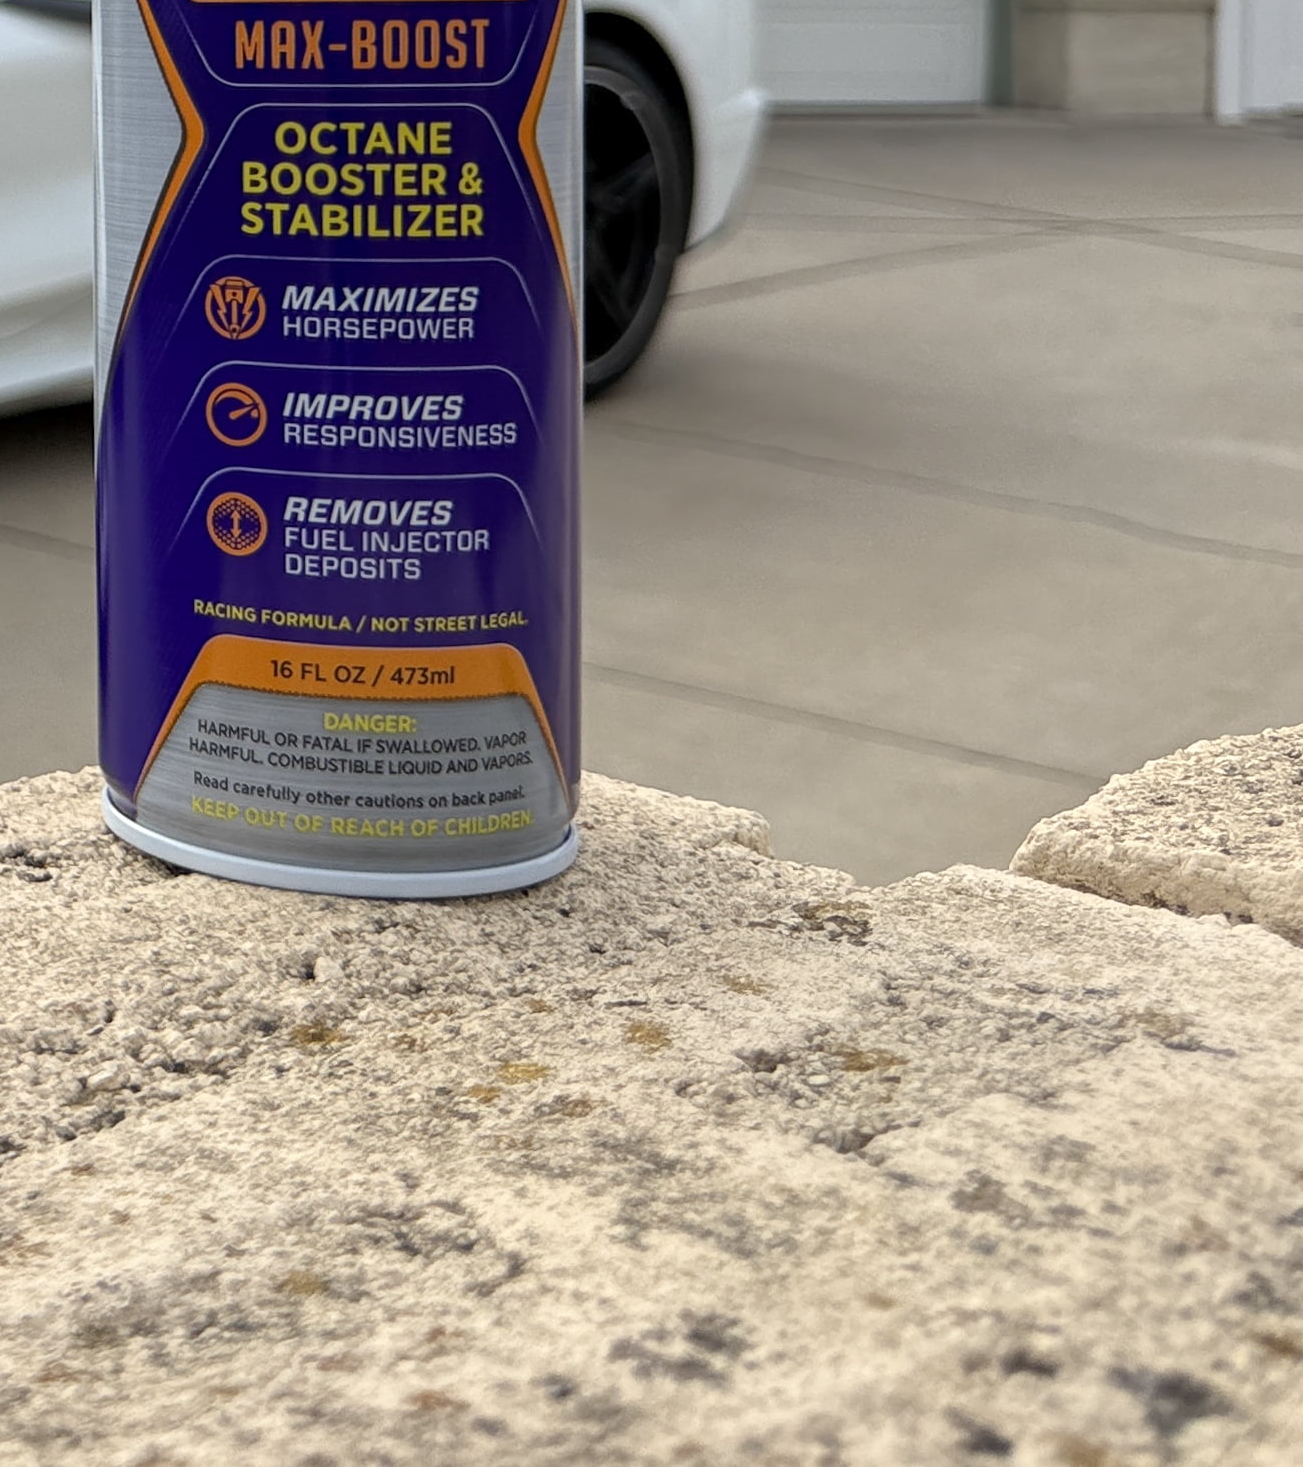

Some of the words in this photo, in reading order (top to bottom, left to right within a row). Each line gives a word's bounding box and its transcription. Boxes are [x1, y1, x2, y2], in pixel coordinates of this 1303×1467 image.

[235, 19, 490, 69] MAX-BOOST
[275, 121, 453, 155] OCTANE
[242, 162, 448, 196] BOOSTER
[458, 163, 484, 195] &
[241, 203, 485, 237] STABILIZER
[282, 285, 480, 313] MAXIMIZES
[283, 316, 474, 340] HORSEPOWER
[283, 392, 465, 421] IMPROVES
[283, 422, 518, 448] RESPONSIVENESS
[283, 496, 453, 526] REMOVES
[284, 527, 354, 552] FUEL
[362, 529, 490, 554] INJECTOR
[285, 553, 421, 580] DEPOSITS
[193, 598, 257, 623] RACING
[261, 608, 352, 632] FORMULA
[356, 615, 367, 633] /
[371, 616, 410, 633] NOT
[414, 614, 478, 633] STREET
[270, 659, 293, 680] 16
[300, 662, 327, 683] FL
[334, 664, 366, 686] OZ
[371, 664, 386, 688] /
[390, 665, 455, 685] 473ml
[198, 718, 270, 746] HARMFUL
[274, 732, 298, 748] OR
[302, 734, 353, 753] FATAL
[357, 738, 374, 754] IF
[375, 737, 481, 755] SWALLOWED.
[483, 730, 527, 750] VAPOR
[324, 711, 417, 733] DANGER:
[189, 737, 264, 765] HARMFUL.
[268, 751, 384, 775] COMBUSTIBLE
[388, 759, 443, 776] LIQUID
[445, 758, 479, 774] AND
[194, 770, 229, 792] Read
[233, 782, 301, 805] carefully
[306, 790, 351, 808] other
[355, 792, 424, 810] cautions
[428, 795, 448, 809] on
[452, 790, 487, 808] back
[192, 795, 240, 821] KEEP
[245, 806, 289, 829] OUT
[294, 813, 324, 833] OF
[331, 816, 405, 836] REACH
[410, 818, 440, 837] OF
